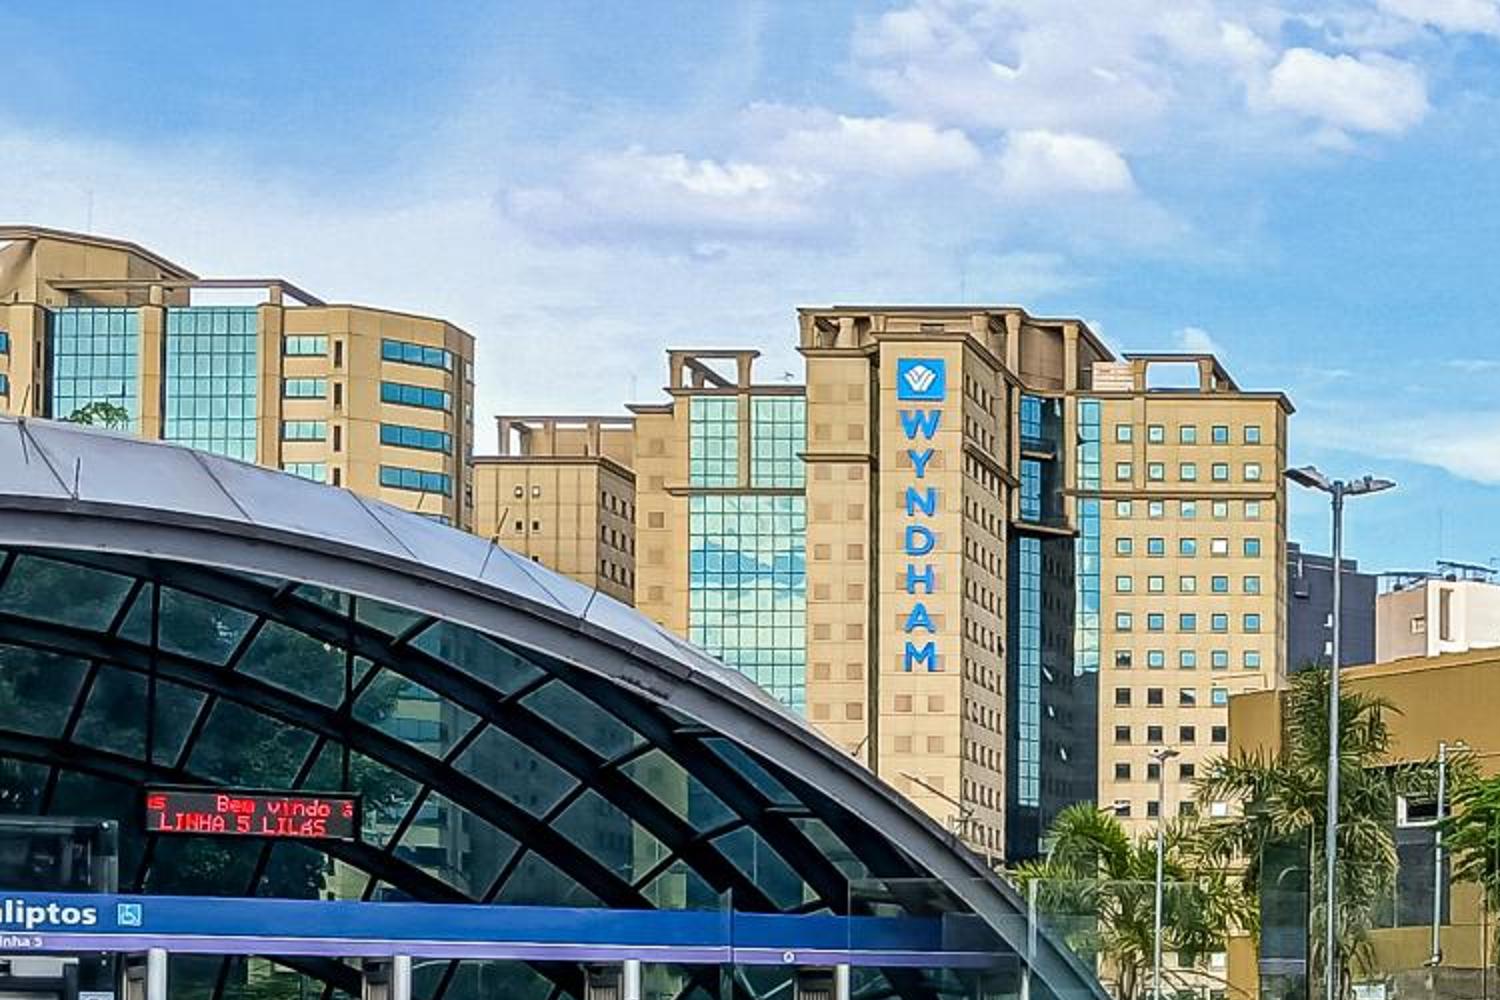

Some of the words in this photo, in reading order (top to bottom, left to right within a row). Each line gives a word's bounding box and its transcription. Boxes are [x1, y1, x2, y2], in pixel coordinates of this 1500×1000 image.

[900, 409, 942, 672] WYNDHAM
[267, 799, 331, 817] vindo
[160, 812, 225, 832] LINHA
[236, 815, 250, 833] 5
[0, 899, 97, 928] liptos
